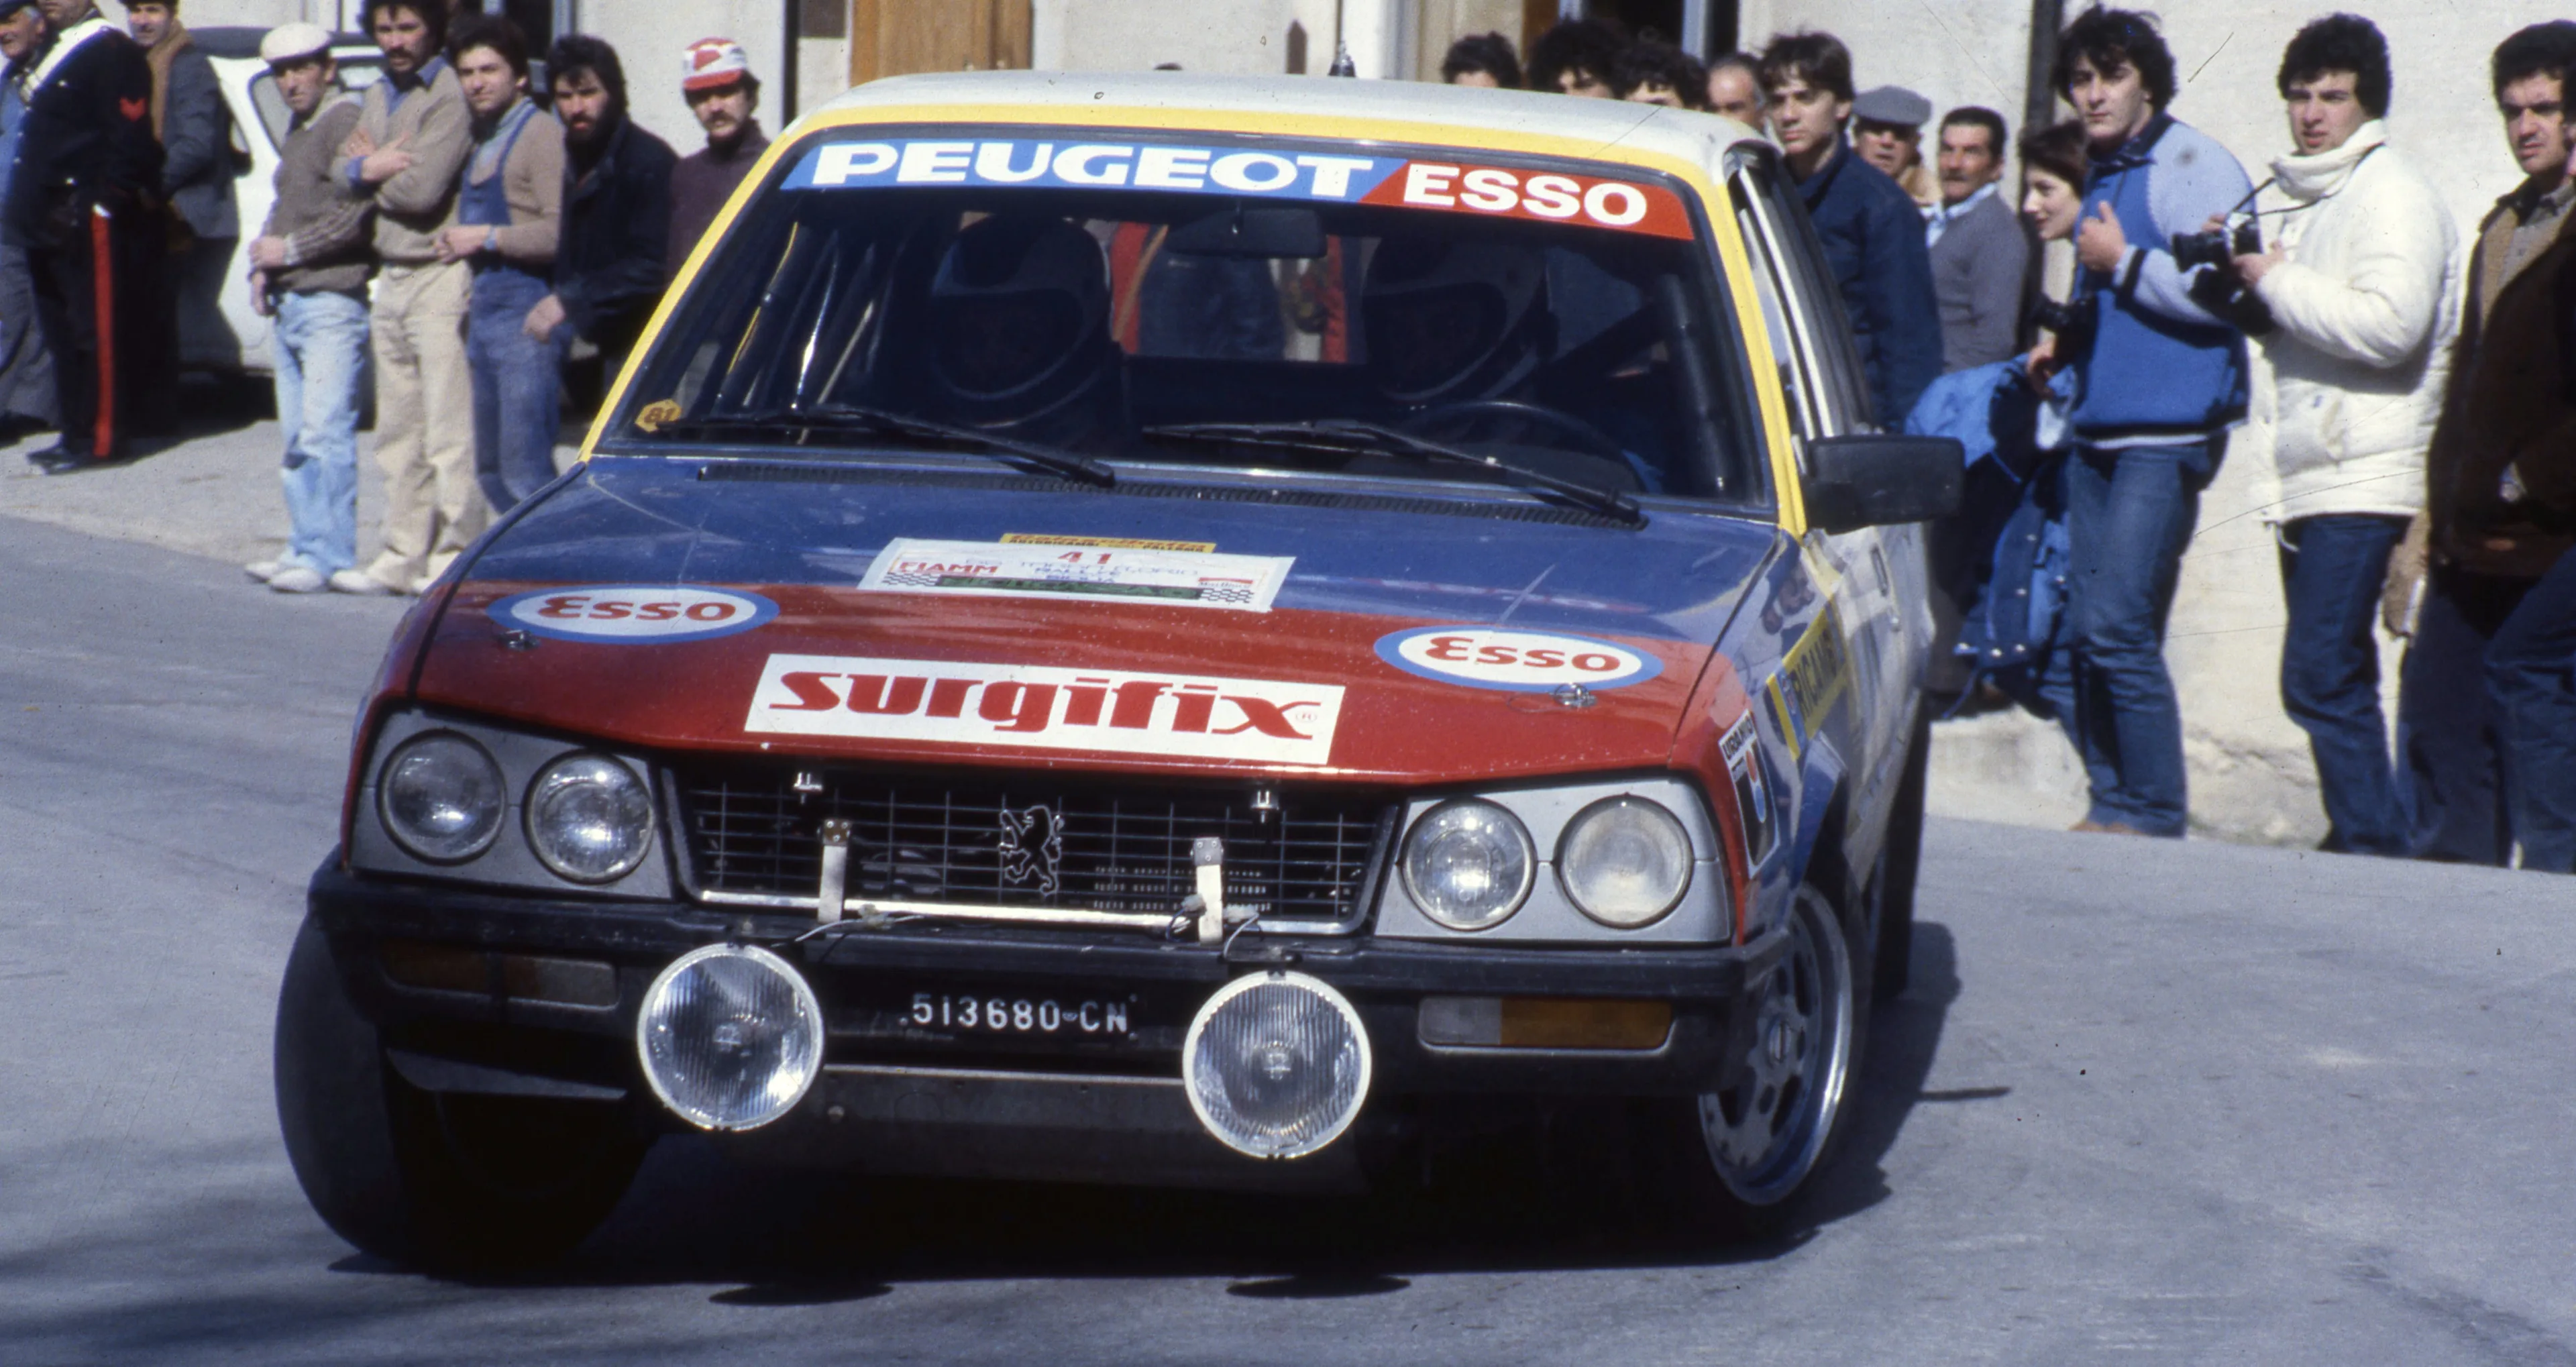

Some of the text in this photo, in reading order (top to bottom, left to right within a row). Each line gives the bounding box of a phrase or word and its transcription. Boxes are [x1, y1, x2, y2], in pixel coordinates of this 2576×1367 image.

[811, 142, 1648, 226] PEUGEOT ESSO
[1057, 550, 1114, 564] 41
[898, 561, 999, 575] FIAMM
